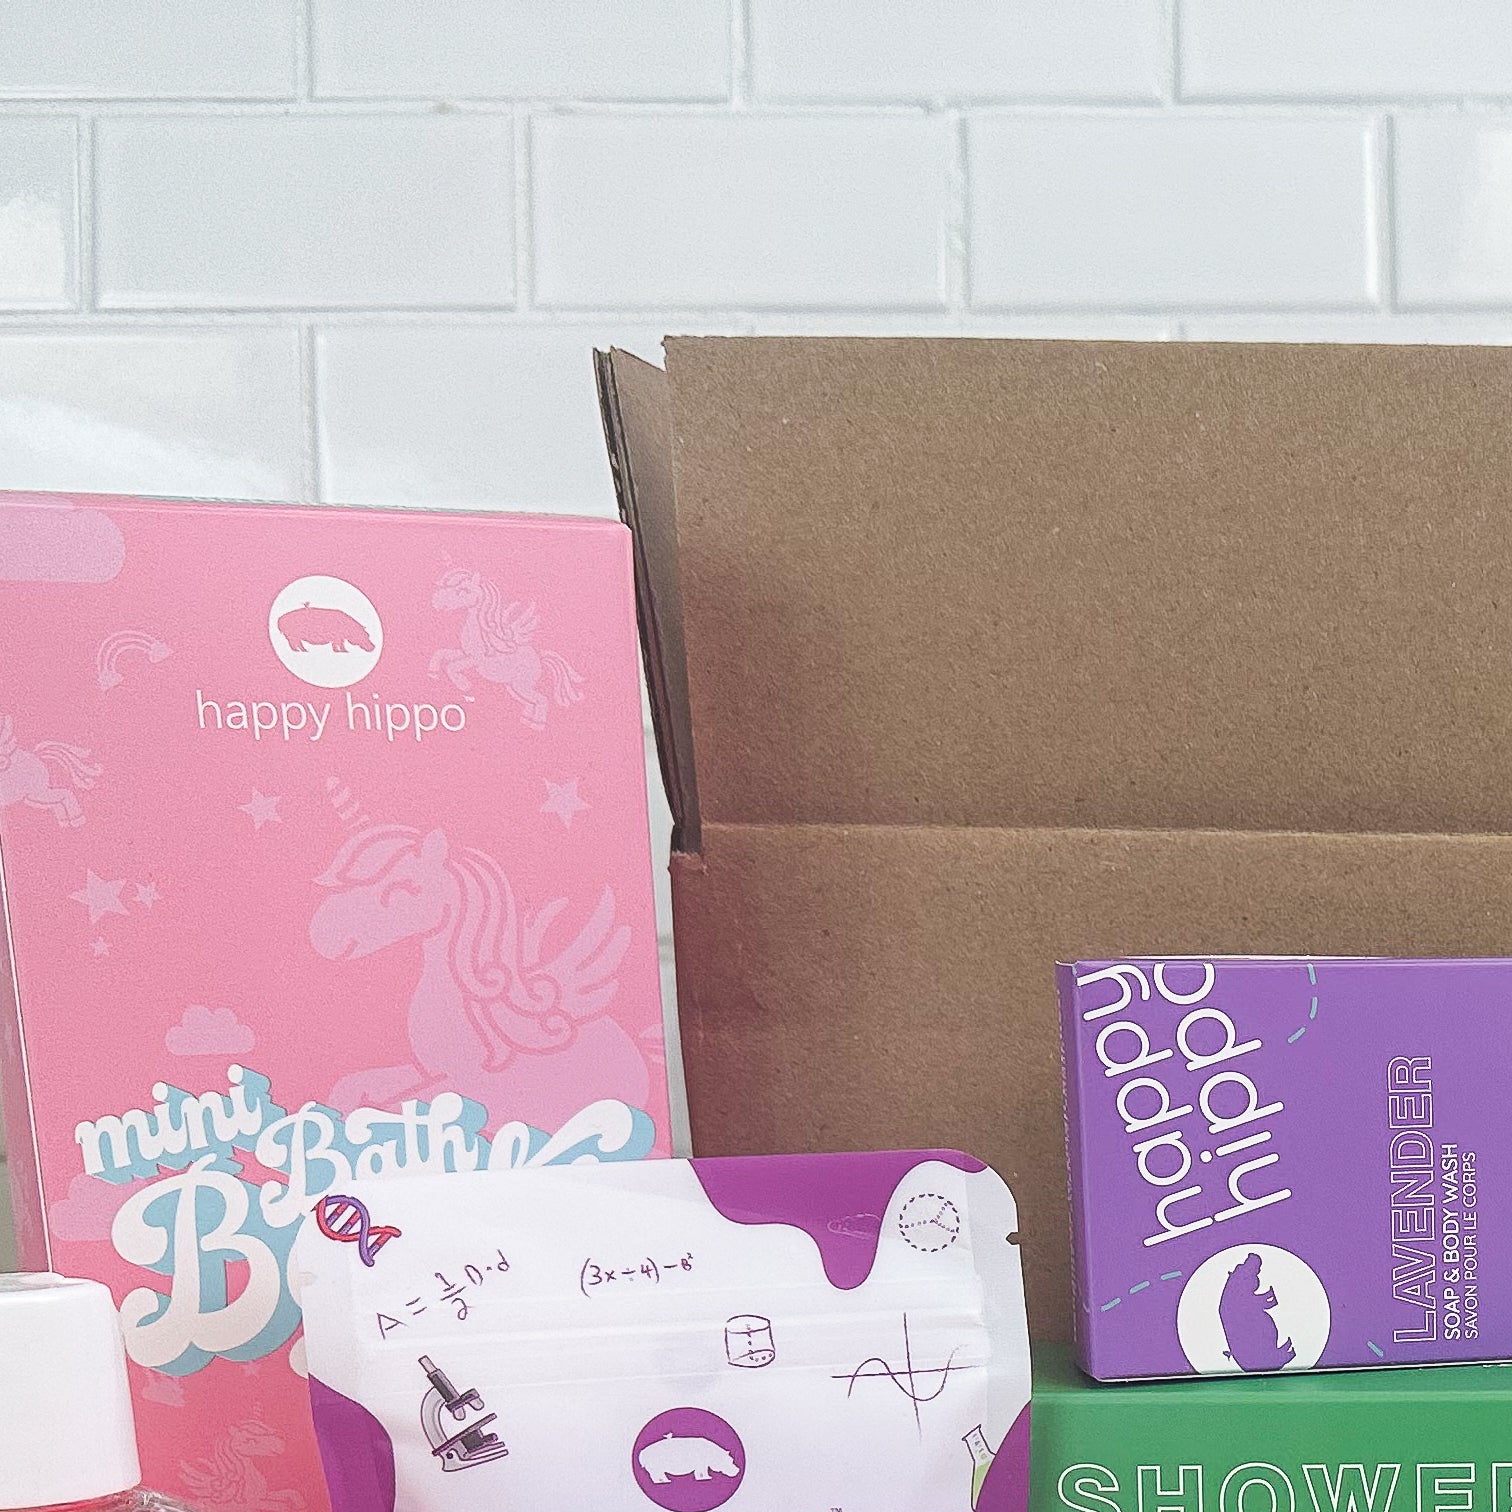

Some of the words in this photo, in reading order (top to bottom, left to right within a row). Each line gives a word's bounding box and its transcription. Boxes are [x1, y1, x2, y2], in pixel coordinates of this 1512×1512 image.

[196, 689, 331, 741] happy
[346, 691, 466, 742] hippo
[74, 1063, 268, 1178] mini
[1077, 963, 1214, 1247] happy
[1386, 1055, 1438, 1343] LAVENDER
[1440, 1143, 1460, 1203] WASH
[1462, 1151, 1478, 1208] CORPS
[1441, 1207, 1461, 1263] BODY
[1462, 1211, 1478, 1231] LE
[1442, 1266, 1461, 1284] &
[1463, 1234, 1479, 1280] POUR
[1442, 1286, 1461, 1341] SOAP
[1463, 1284, 1479, 1340] SAVON
